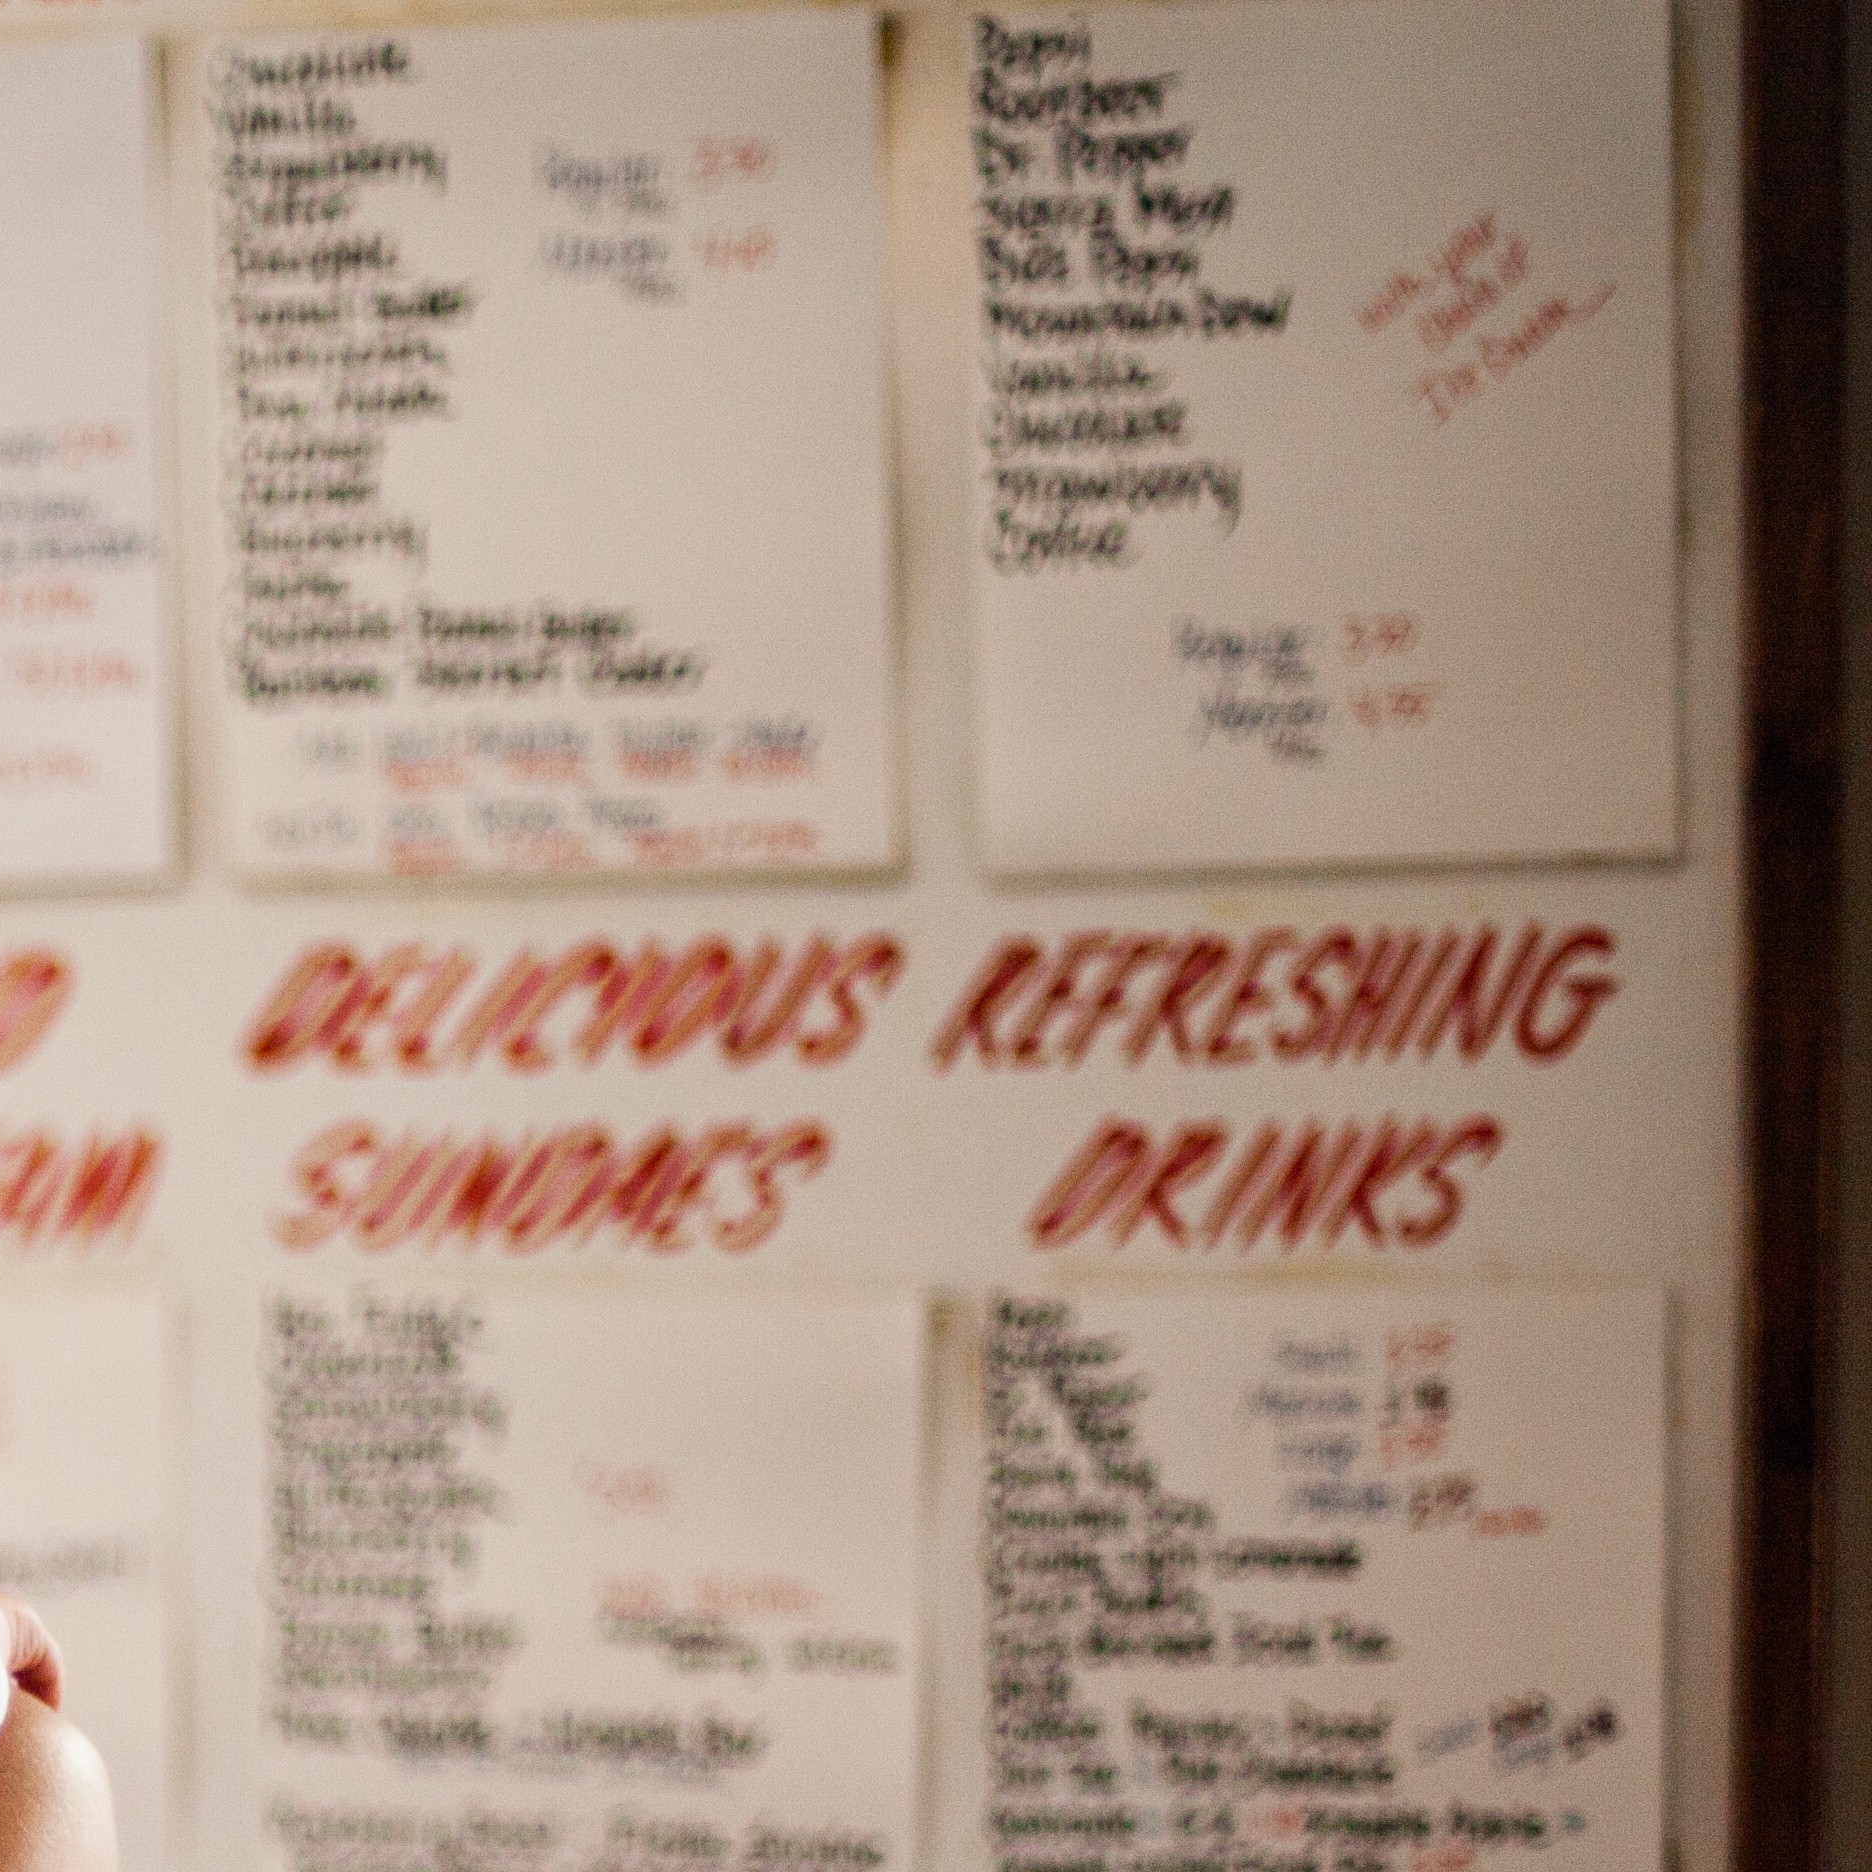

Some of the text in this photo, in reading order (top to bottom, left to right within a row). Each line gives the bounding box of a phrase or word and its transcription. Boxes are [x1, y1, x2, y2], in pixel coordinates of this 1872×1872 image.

[239, 926, 906, 1081] DELICIOUS
[928, 914, 1624, 1077] REFRESHING
[267, 1112, 835, 1256] SUNDAES
[1024, 1110, 1507, 1252] DRINKS
